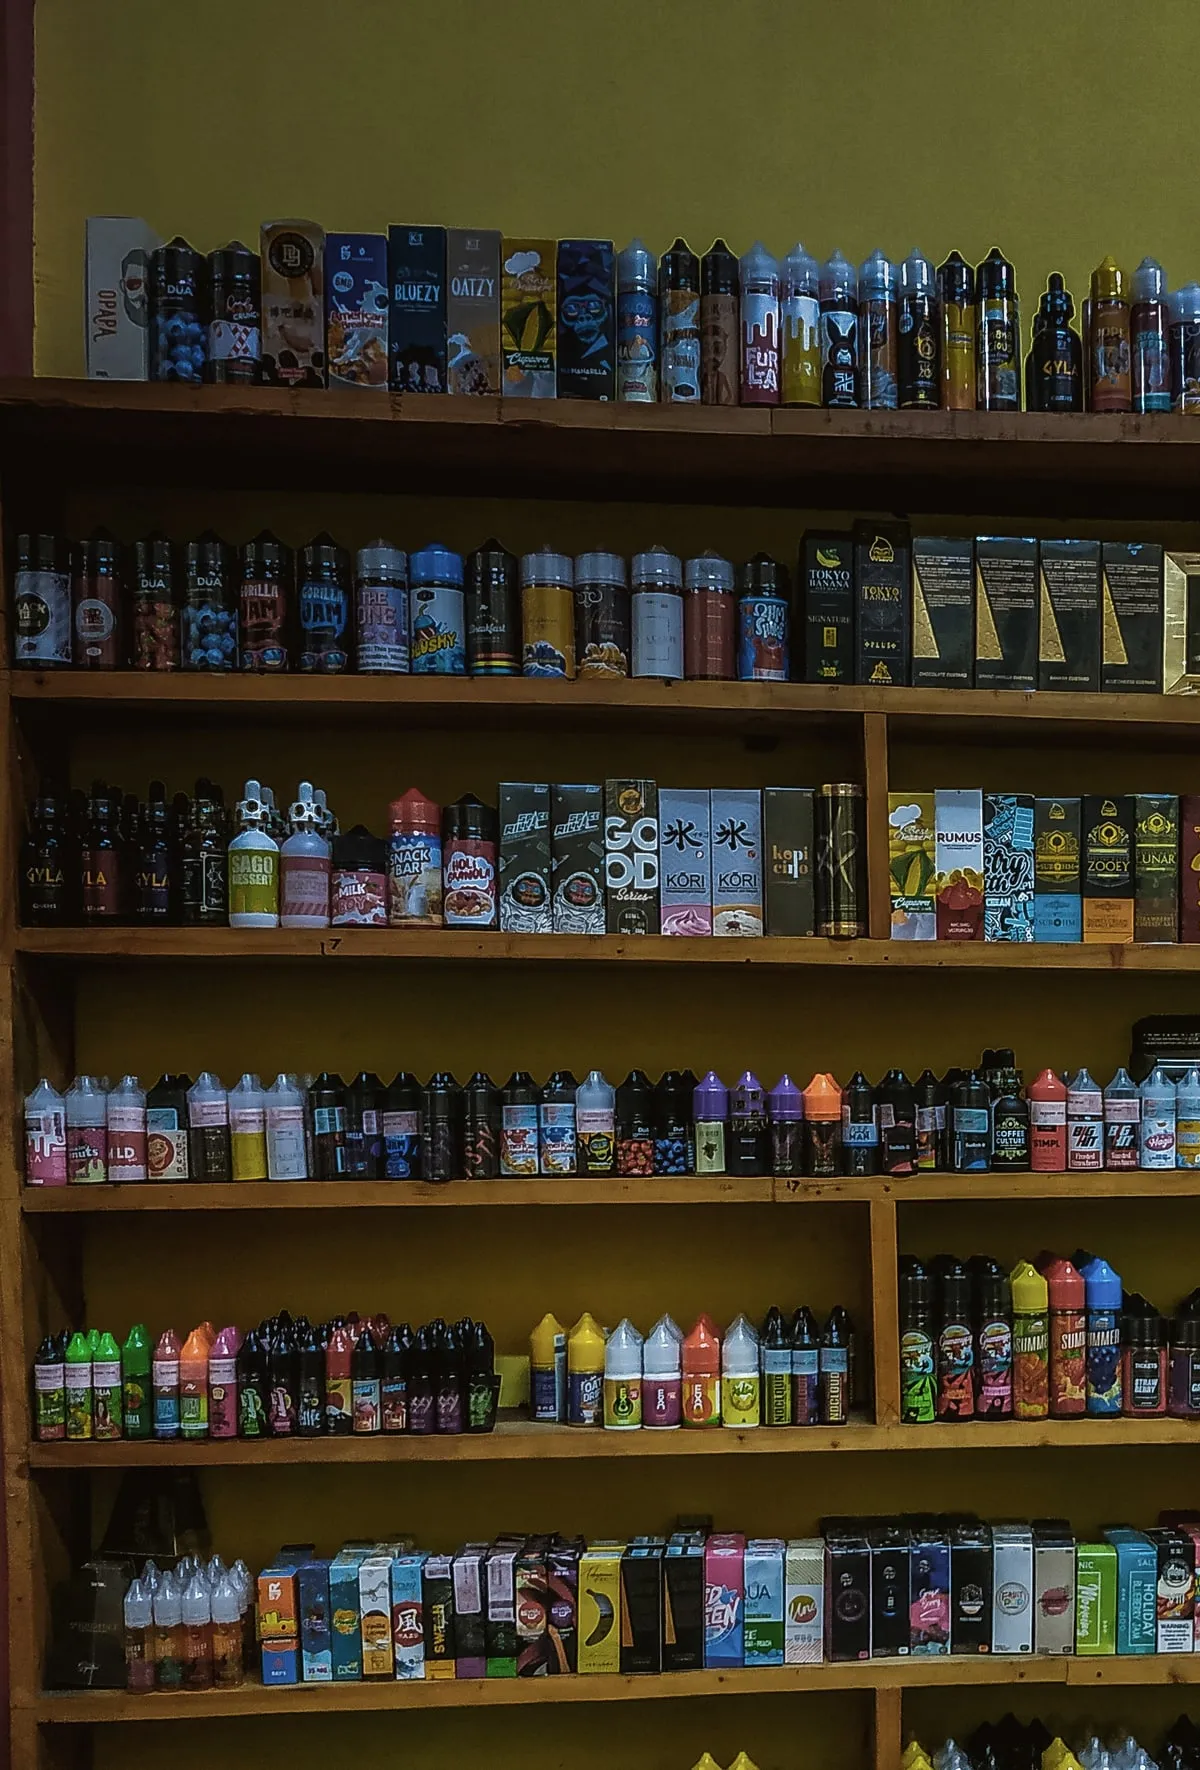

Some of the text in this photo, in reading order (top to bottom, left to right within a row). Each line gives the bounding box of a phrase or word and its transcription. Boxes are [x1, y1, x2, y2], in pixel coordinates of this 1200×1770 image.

[167, 285, 193, 297] DUA
[393, 284, 440, 302] BLUEZY
[451, 276, 495, 297] OATZY
[93, 289, 118, 342] OPAPA
[809, 569, 850, 580] TOKYO
[141, 579, 165, 589] DUA
[197, 577, 222, 588] DUA
[809, 580, 850, 588] BANANA
[301, 583, 345, 602] GORILLA
[862, 586, 899, 598] TOKYO
[605, 817, 657, 850] GO
[937, 833, 981, 843] RUMUS
[389, 849, 429, 866] SNACK
[232, 855, 273, 874] SAGO
[396, 862, 422, 876] BAR
[605, 853, 658, 888] OD
[1087, 860, 1130, 872] ZOOEY
[232, 874, 273, 886] DESSERT
[666, 873, 705, 888] KŌRI
[719, 872, 757, 887] KŌRI
[338, 883, 366, 898] MILK
[996, 1130, 1025, 1138] COFFEE
[996, 1137, 1026, 1145] CULTURE
[1135, 1362, 1157, 1370] TICKETS
[1135, 1378, 1158, 1387] STRAW
[1134, 1385, 1156, 1394] BERRY
[1143, 1583, 1155, 1637] HOLIDAY
[395, 1609, 422, 1633] 風
